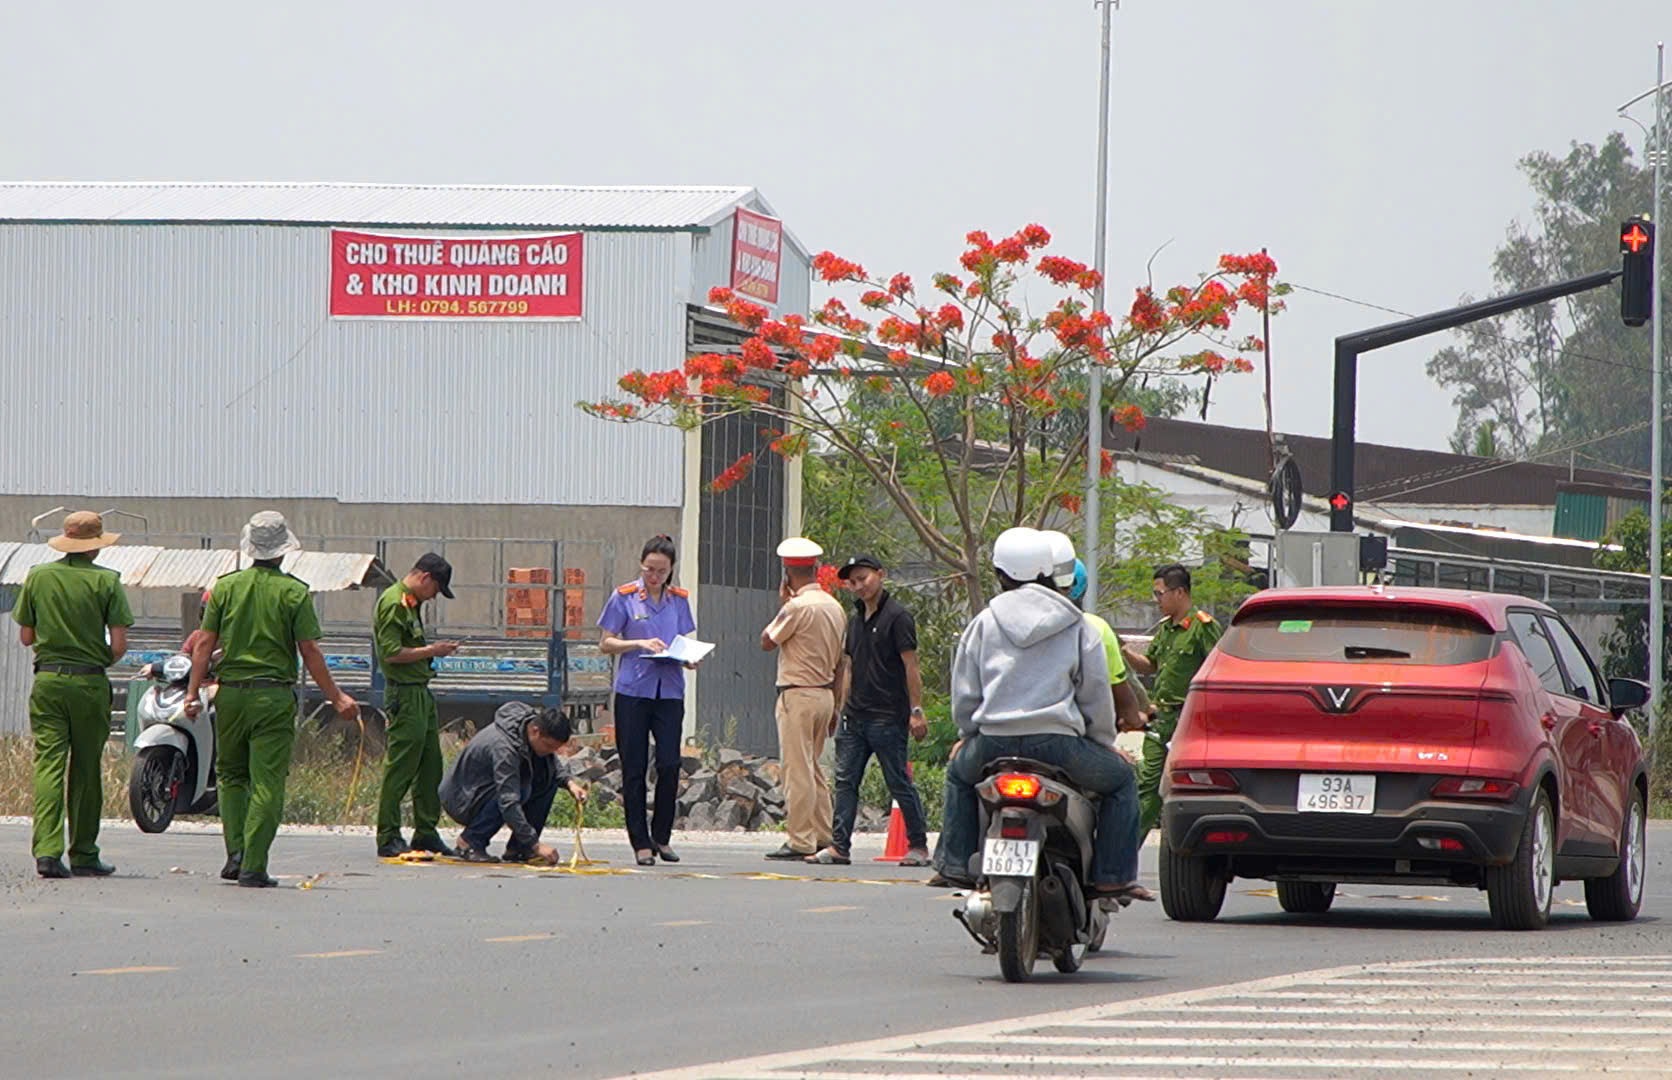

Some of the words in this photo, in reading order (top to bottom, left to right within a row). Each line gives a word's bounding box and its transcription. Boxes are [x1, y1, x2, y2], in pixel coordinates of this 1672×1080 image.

[346, 242, 388, 265] CHO
[393, 240, 444, 266] THUÊ
[526, 240, 568, 266] CÁO
[345, 273, 364, 296] &
[371, 273, 418, 296] KHO
[425, 274, 482, 297] KINH
[488, 273, 567, 297] DOANH
[386, 300, 417, 313] LH:
[1321, 777, 1353, 793] 93A
[1307, 794, 1366, 810] 496.97
